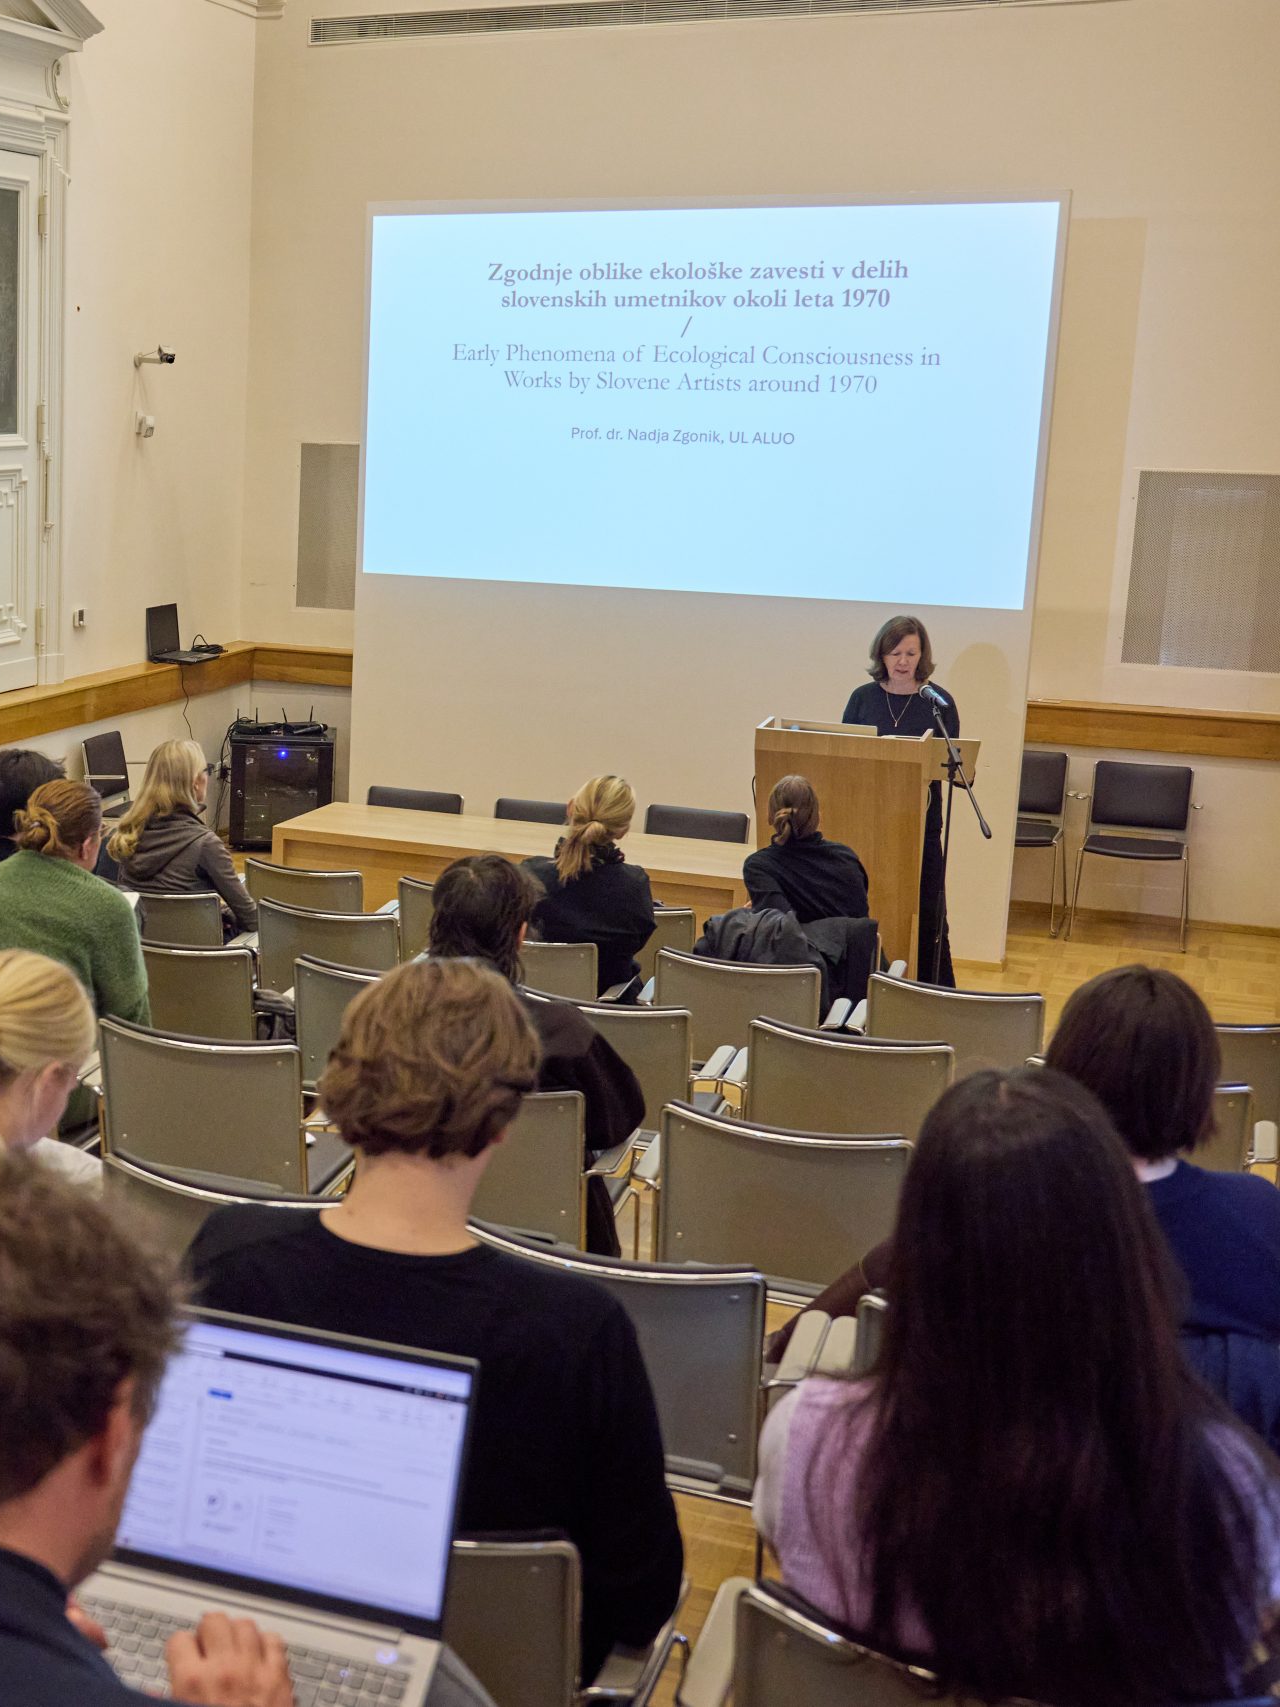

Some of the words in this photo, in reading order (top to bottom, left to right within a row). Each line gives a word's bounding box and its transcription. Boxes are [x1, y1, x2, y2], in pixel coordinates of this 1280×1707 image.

[488, 263, 573, 287] Zgodnje
[579, 262, 643, 281] oblike
[649, 261, 743, 280] ekološke
[750, 260, 825, 279] zavesti
[831, 266, 844, 279] v
[852, 260, 909, 279] delih
[501, 290, 607, 308] slovenskih
[614, 289, 727, 308] umetnikov
[733, 289, 787, 307] okoli
[793, 289, 835, 308] leta
[842, 288, 891, 308] 1970
[452, 343, 500, 367] Early
[506, 343, 616, 363] Phenomena
[622, 344, 646, 363] of
[653, 345, 755, 370] Ecological
[762, 345, 914, 366] Consciousness
[920, 346, 941, 366] in
[504, 370, 563, 389] Works
[569, 370, 591, 394] by
[596, 371, 670, 390] Slovene
[677, 372, 741, 391] Artists
[748, 374, 820, 393] around
[829, 374, 878, 394] 1970
[571, 427, 602, 440] Prof.
[606, 428, 624, 440] dr.
[627, 429, 670, 443] Nadja
[672, 429, 725, 445] Zgonik,
[729, 431, 748, 444] UL
[752, 431, 795, 445] ALUO
